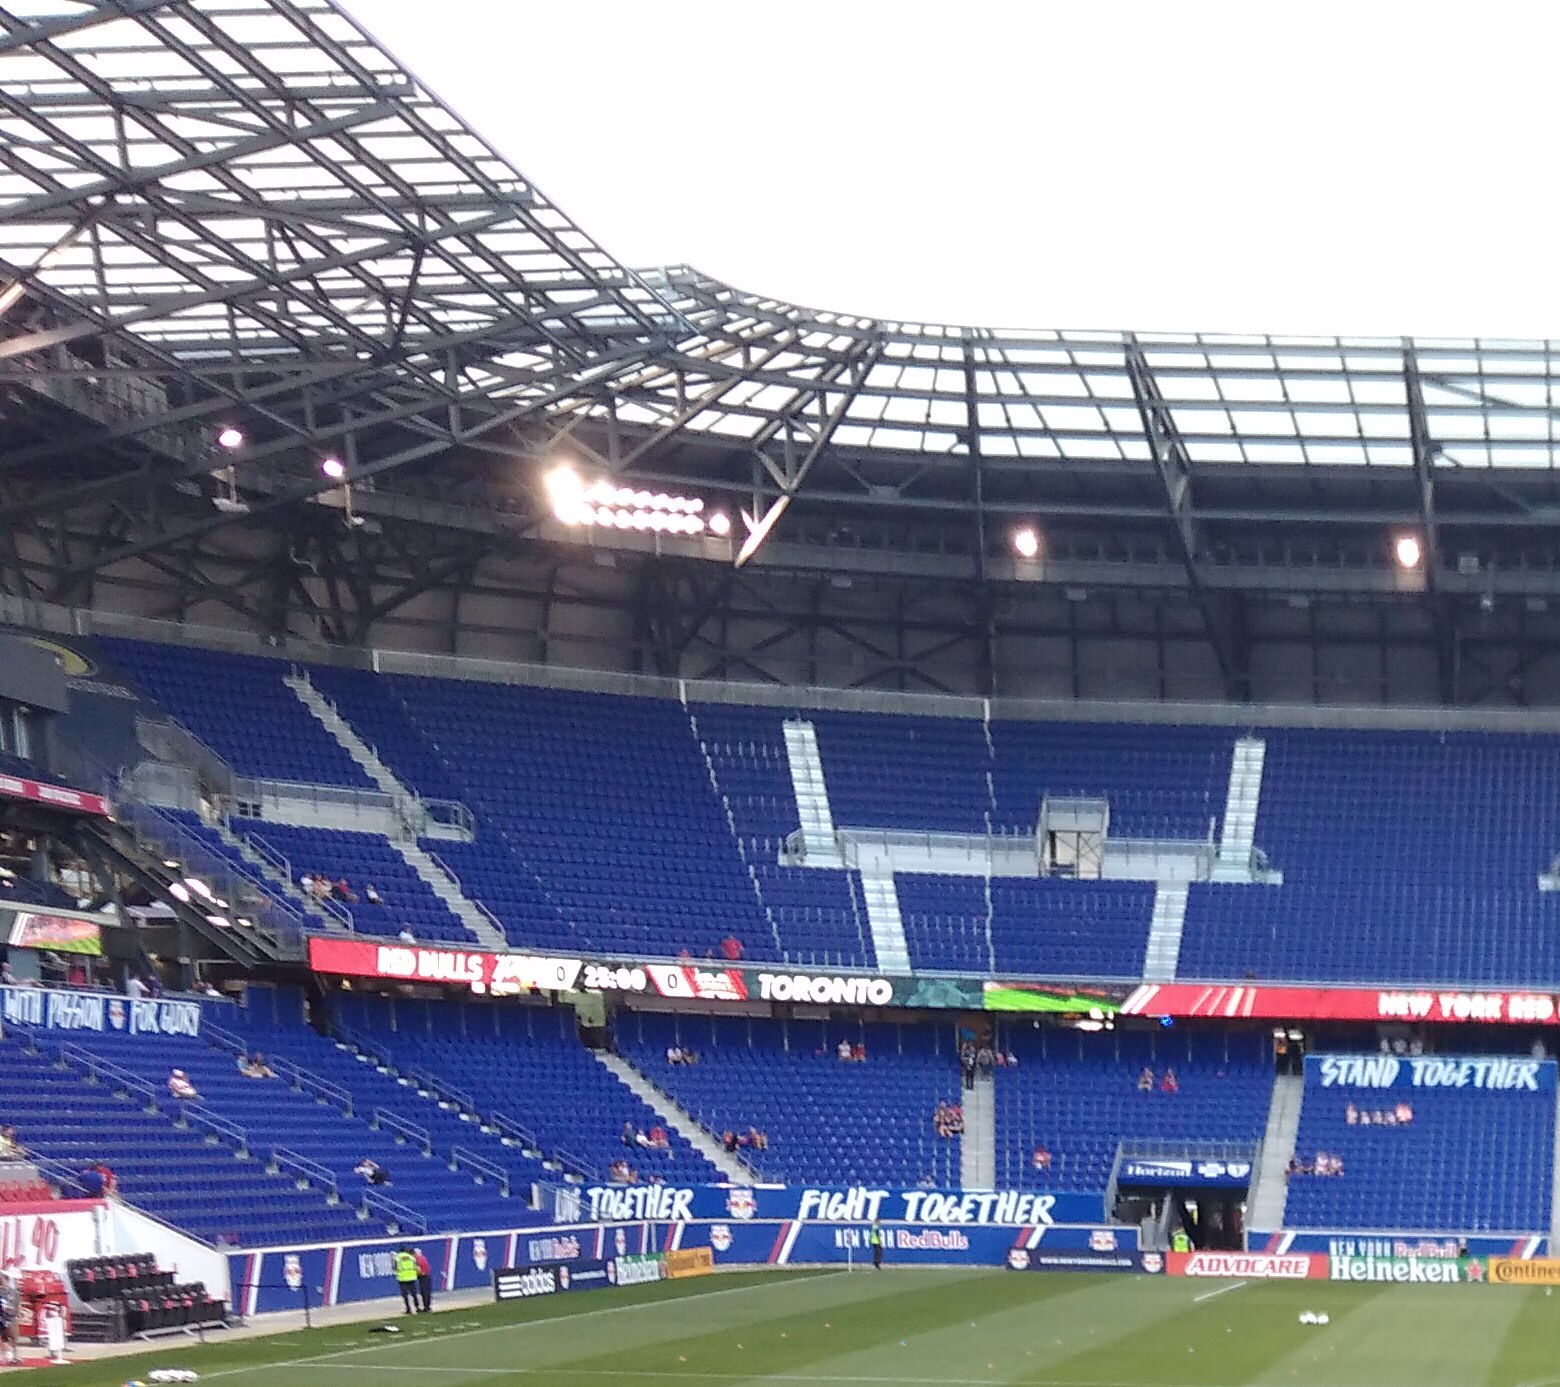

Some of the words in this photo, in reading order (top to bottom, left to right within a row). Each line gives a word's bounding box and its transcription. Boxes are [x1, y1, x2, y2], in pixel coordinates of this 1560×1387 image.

[758, 973, 893, 1005] TORONTO
[1378, 991, 1433, 1017] NEW
[1438, 992, 1503, 1018] YORK
[1319, 1057, 1400, 1088] STAND
[1410, 1058, 1540, 1091] TOGETHER
[586, 1184, 694, 1222] TOGETHER
[798, 1186, 890, 1221] FIGHT
[901, 1189, 1056, 1225] TOGETHER
[1191, 1256, 1307, 1276] ADVOCARE
[1329, 1256, 1460, 1282] Heineken
